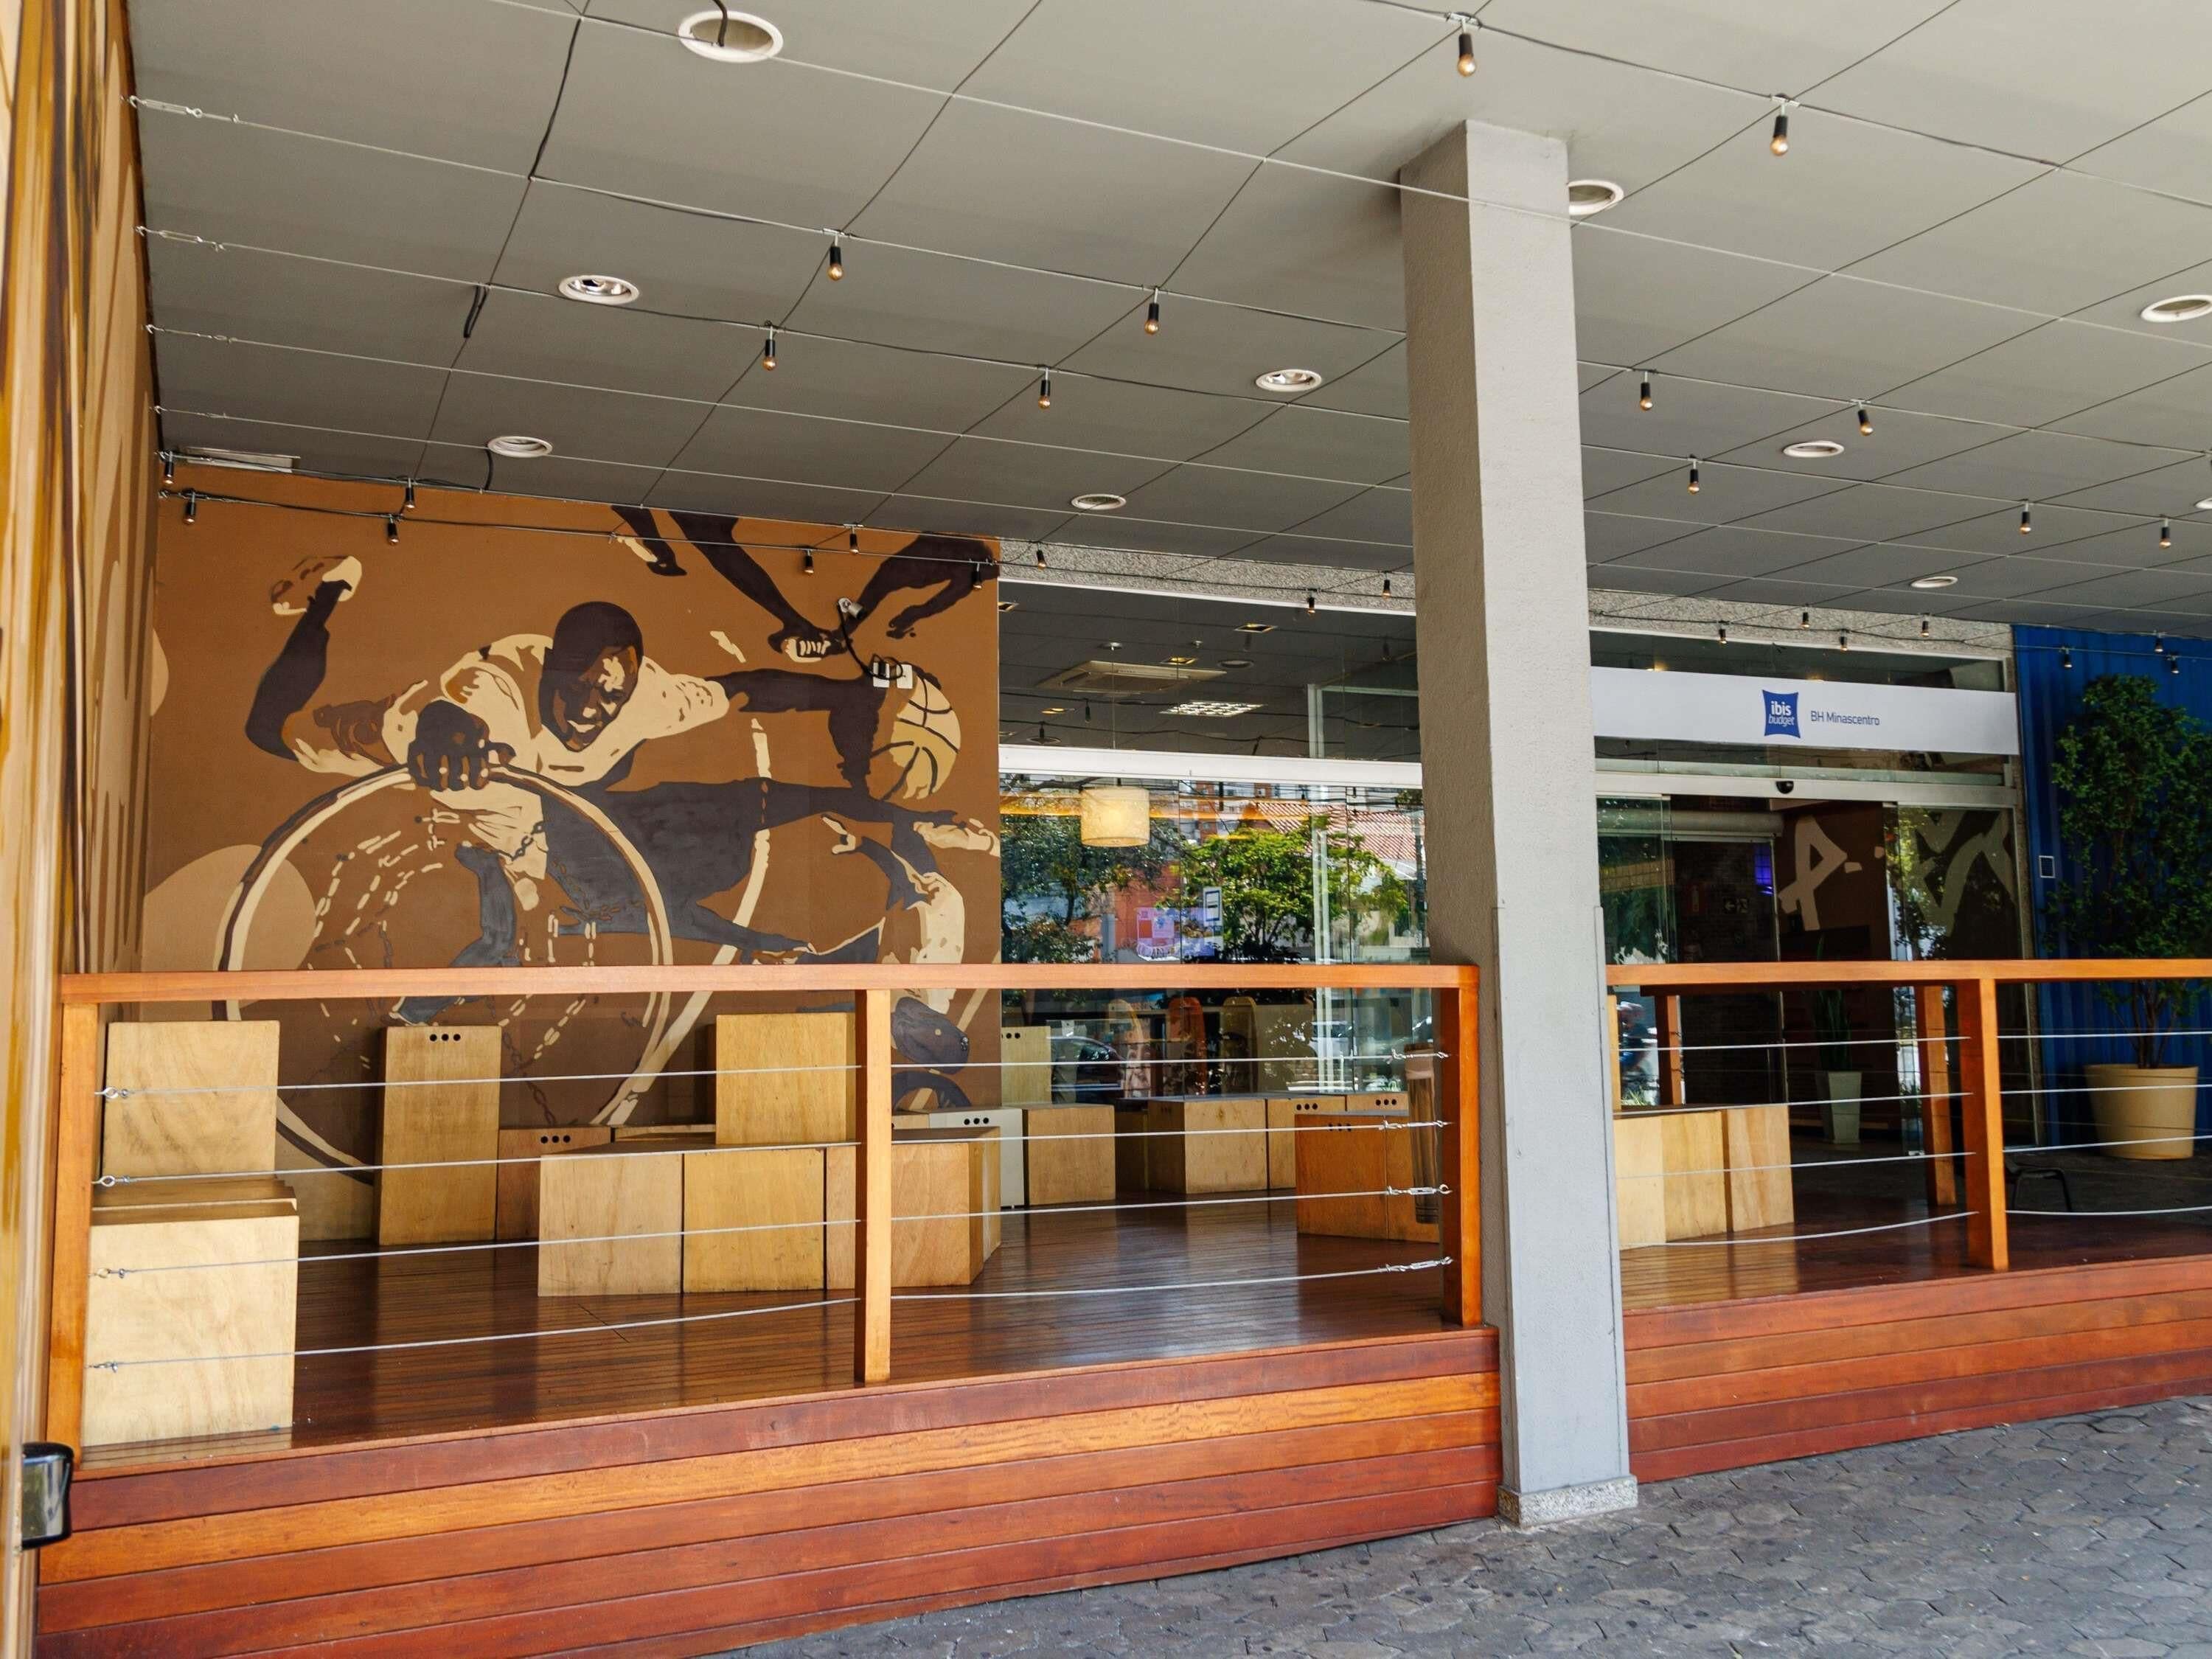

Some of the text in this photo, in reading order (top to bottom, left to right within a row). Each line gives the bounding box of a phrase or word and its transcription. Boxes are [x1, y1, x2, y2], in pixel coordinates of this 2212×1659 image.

[1770, 700, 1792, 716] ibis
[1768, 714, 1795, 727] budget
[1810, 711, 1880, 726] BH Minascentro
